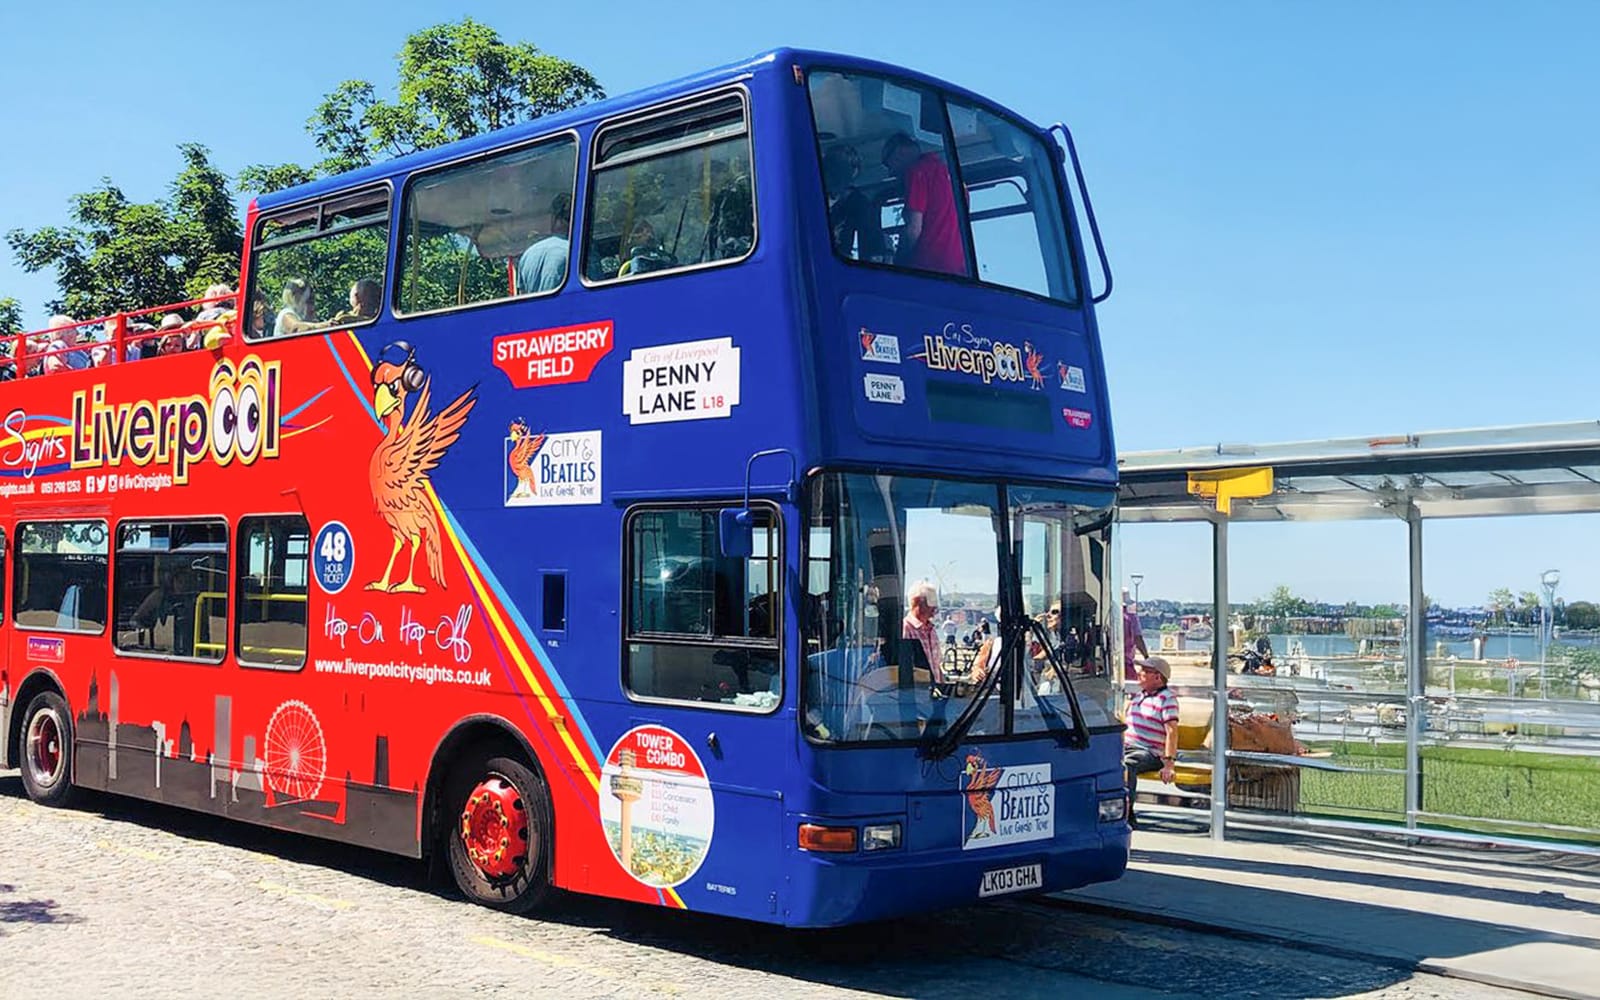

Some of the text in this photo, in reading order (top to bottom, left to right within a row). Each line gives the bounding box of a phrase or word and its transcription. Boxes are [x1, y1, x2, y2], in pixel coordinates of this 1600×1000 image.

[497, 327, 609, 360] STRAWBERRY
[674, 345, 719, 362] Liverpool
[527, 357, 574, 380] FIELD
[924, 335, 1025, 384] Liverpool
[643, 361, 716, 388] PENNY
[871, 381, 897, 391] PENNY
[640, 391, 724, 414] LANE L18
[871, 391, 892, 400] LANE
[71, 354, 281, 484] Liverpool
[3, 408, 66, 477] Sights
[551, 439, 593, 461] CITY &
[541, 454, 596, 483] BEATLES
[321, 532, 346, 562] 48
[323, 573, 344, 584] TICKET
[325, 564, 342, 574] HOUR
[325, 602, 472, 662] Hop-On Hop-Off
[315, 658, 491, 686] www.liverpoolcitysights.co.uk
[636, 733, 673, 751] TOWER
[646, 750, 685, 768] COMBO
[1007, 772, 1034, 791] CITY
[1000, 789, 1050, 821] BEATLES
[983, 866, 1037, 892] LK03 GHA
